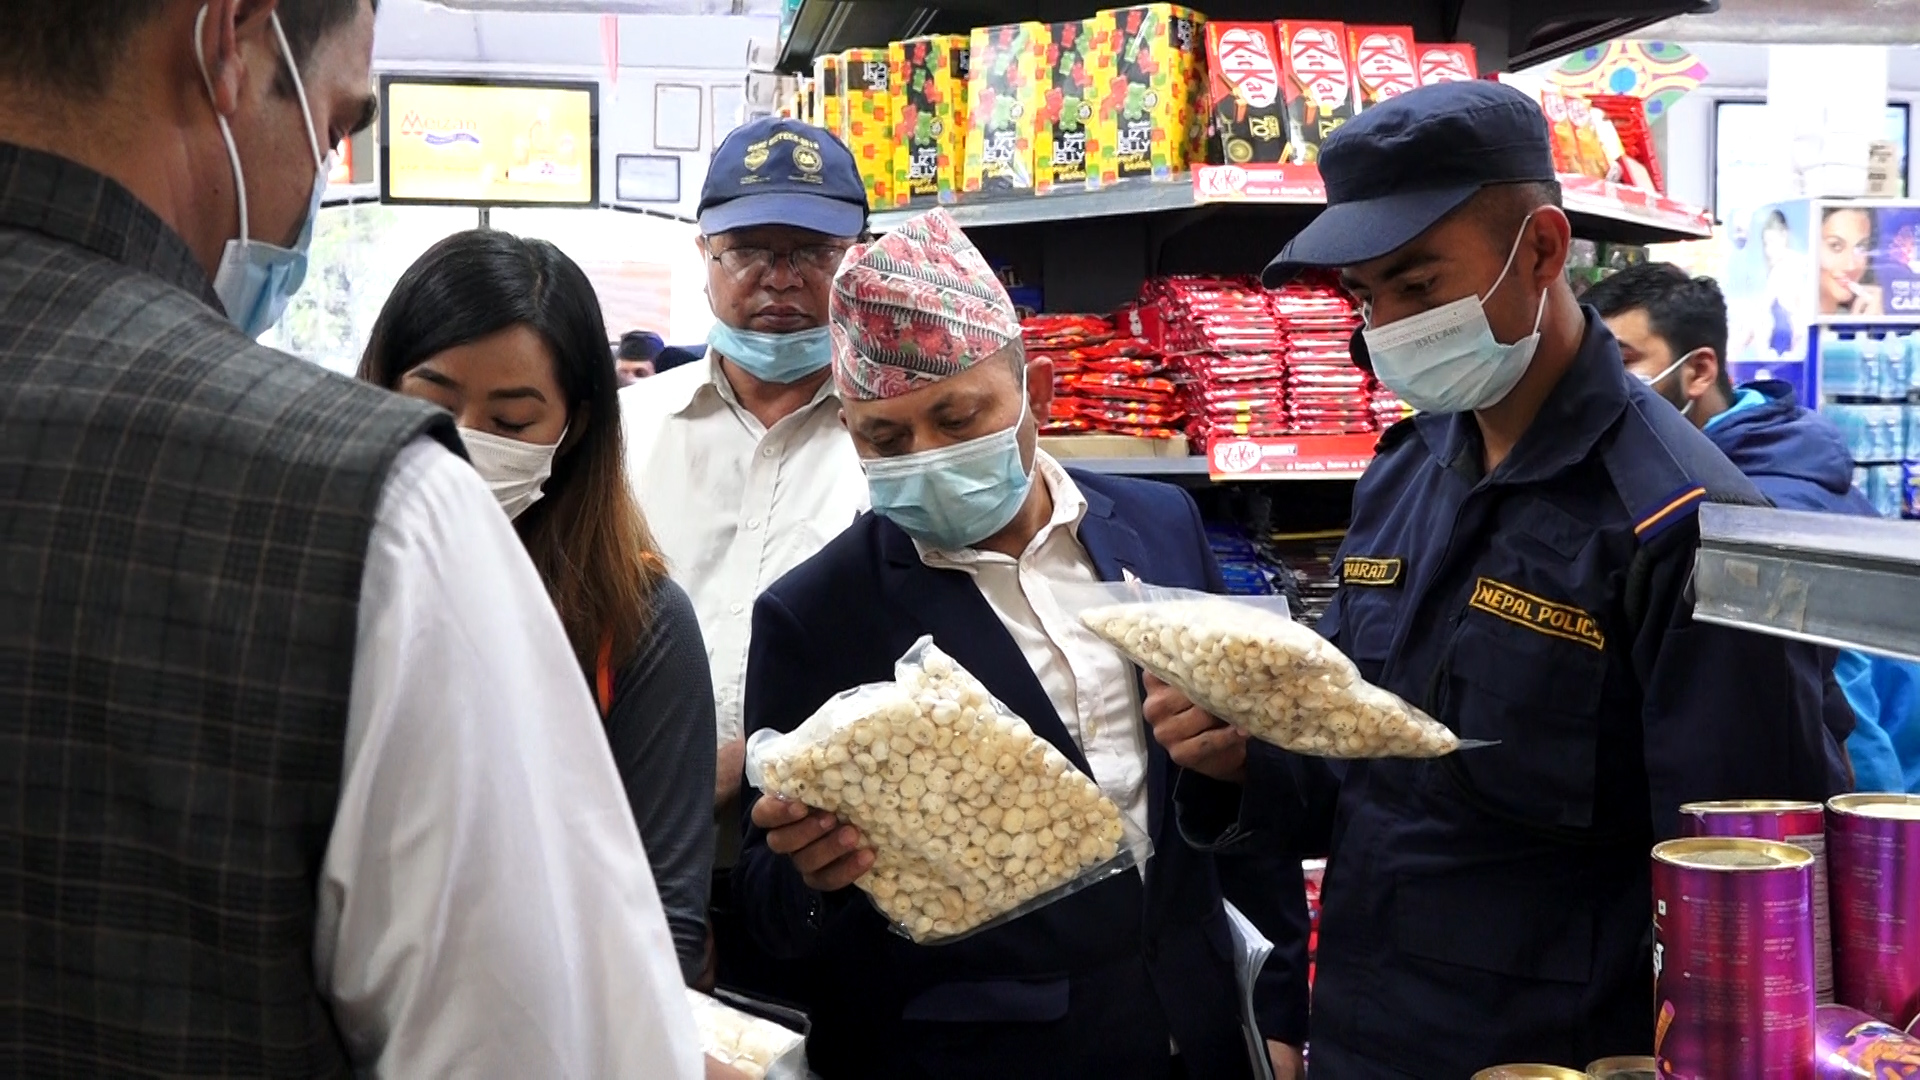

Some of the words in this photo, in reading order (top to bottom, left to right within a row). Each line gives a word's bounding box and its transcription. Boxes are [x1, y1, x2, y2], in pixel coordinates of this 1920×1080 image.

[1221, 40, 1275, 99] KitKat
[1293, 40, 1345, 101] KitKat
[1361, 46, 1414, 97] KitKa
[400, 110, 477, 136] Meizan
[1344, 562, 1388, 578] HARATI
[1478, 585, 1533, 620] NEPAL
